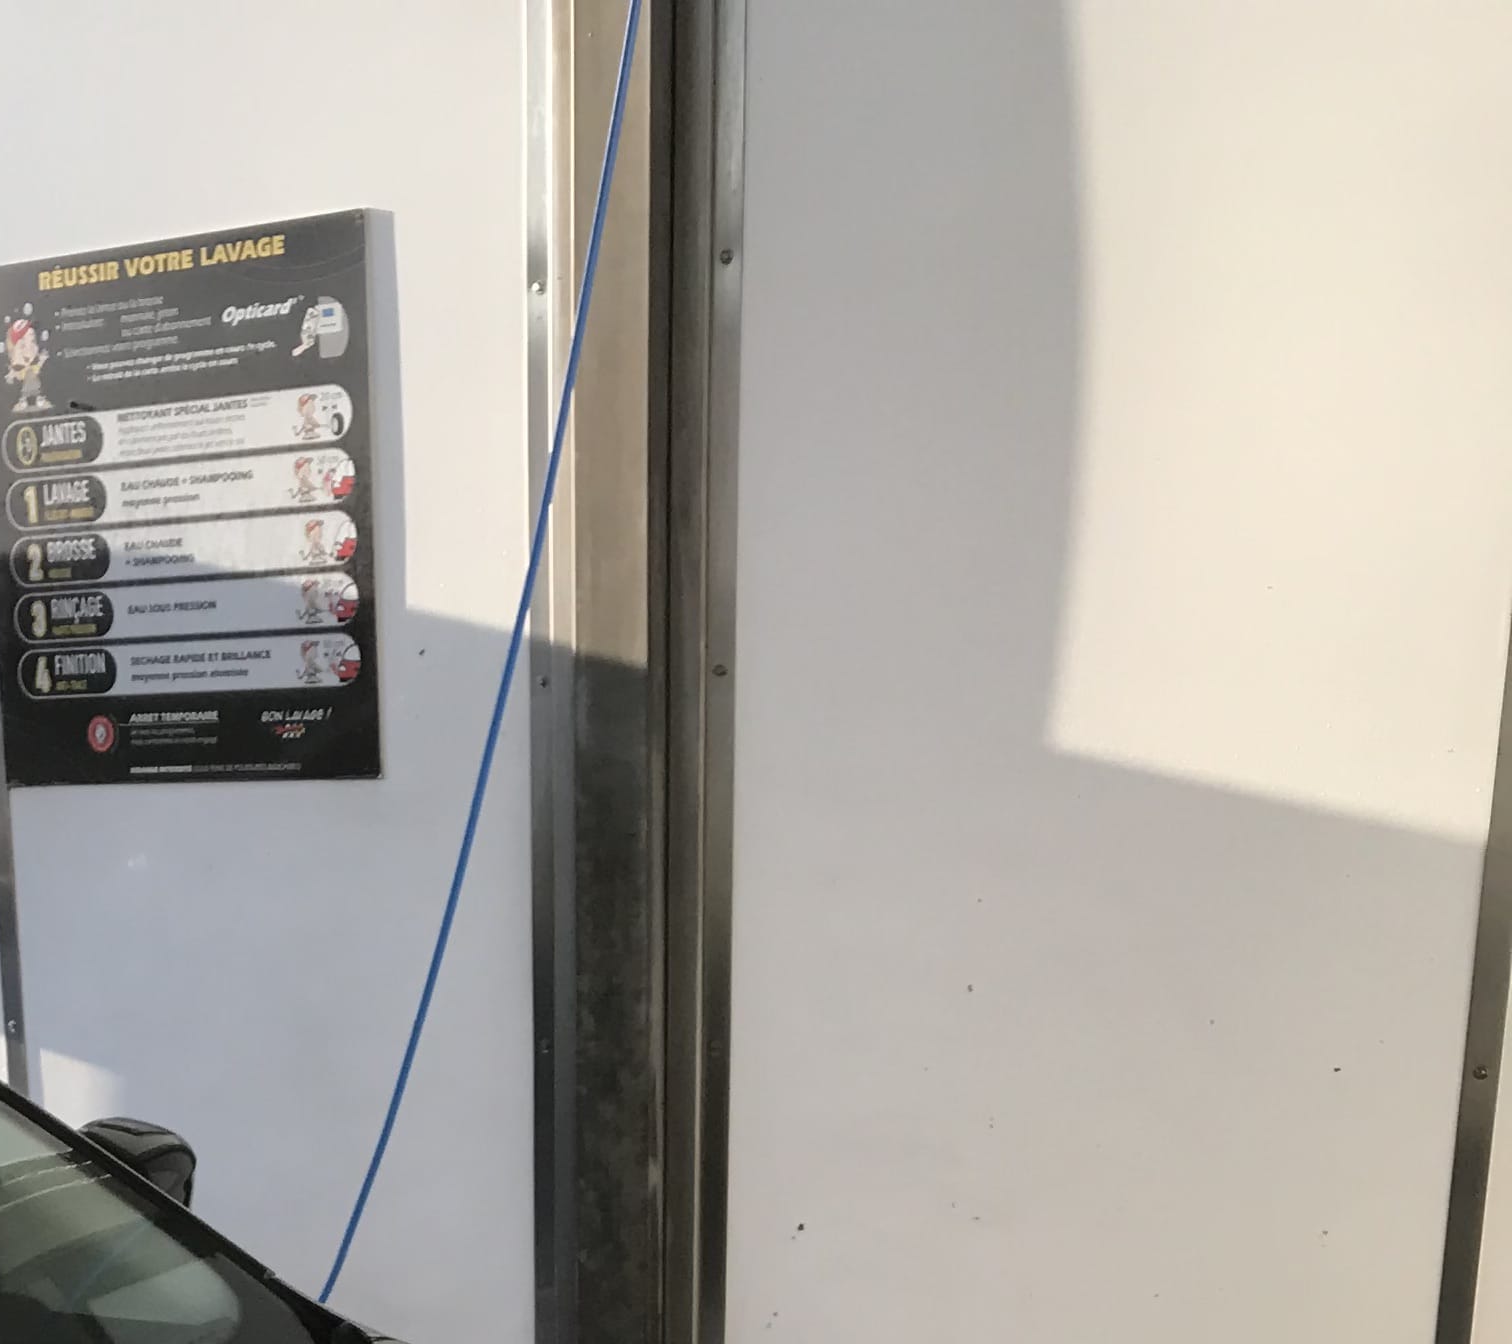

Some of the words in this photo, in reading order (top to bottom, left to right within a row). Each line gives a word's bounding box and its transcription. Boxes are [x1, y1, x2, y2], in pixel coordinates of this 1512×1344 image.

[38, 261, 120, 291] RÉUSSIR
[124, 249, 194, 277] VOTRE
[199, 234, 286, 266] LAVAGE
[221, 297, 294, 326] Opticard
[40, 420, 87, 448] JANTES
[24, 485, 39, 524] 1
[43, 479, 91, 506] LAVAGE
[27, 543, 44, 581] 2
[47, 538, 97, 563] BROSSE
[31, 599, 48, 638] 3
[50, 595, 105, 624] RINÇAGE
[35, 655, 53, 694] 4
[54, 652, 107, 676] FINITION
